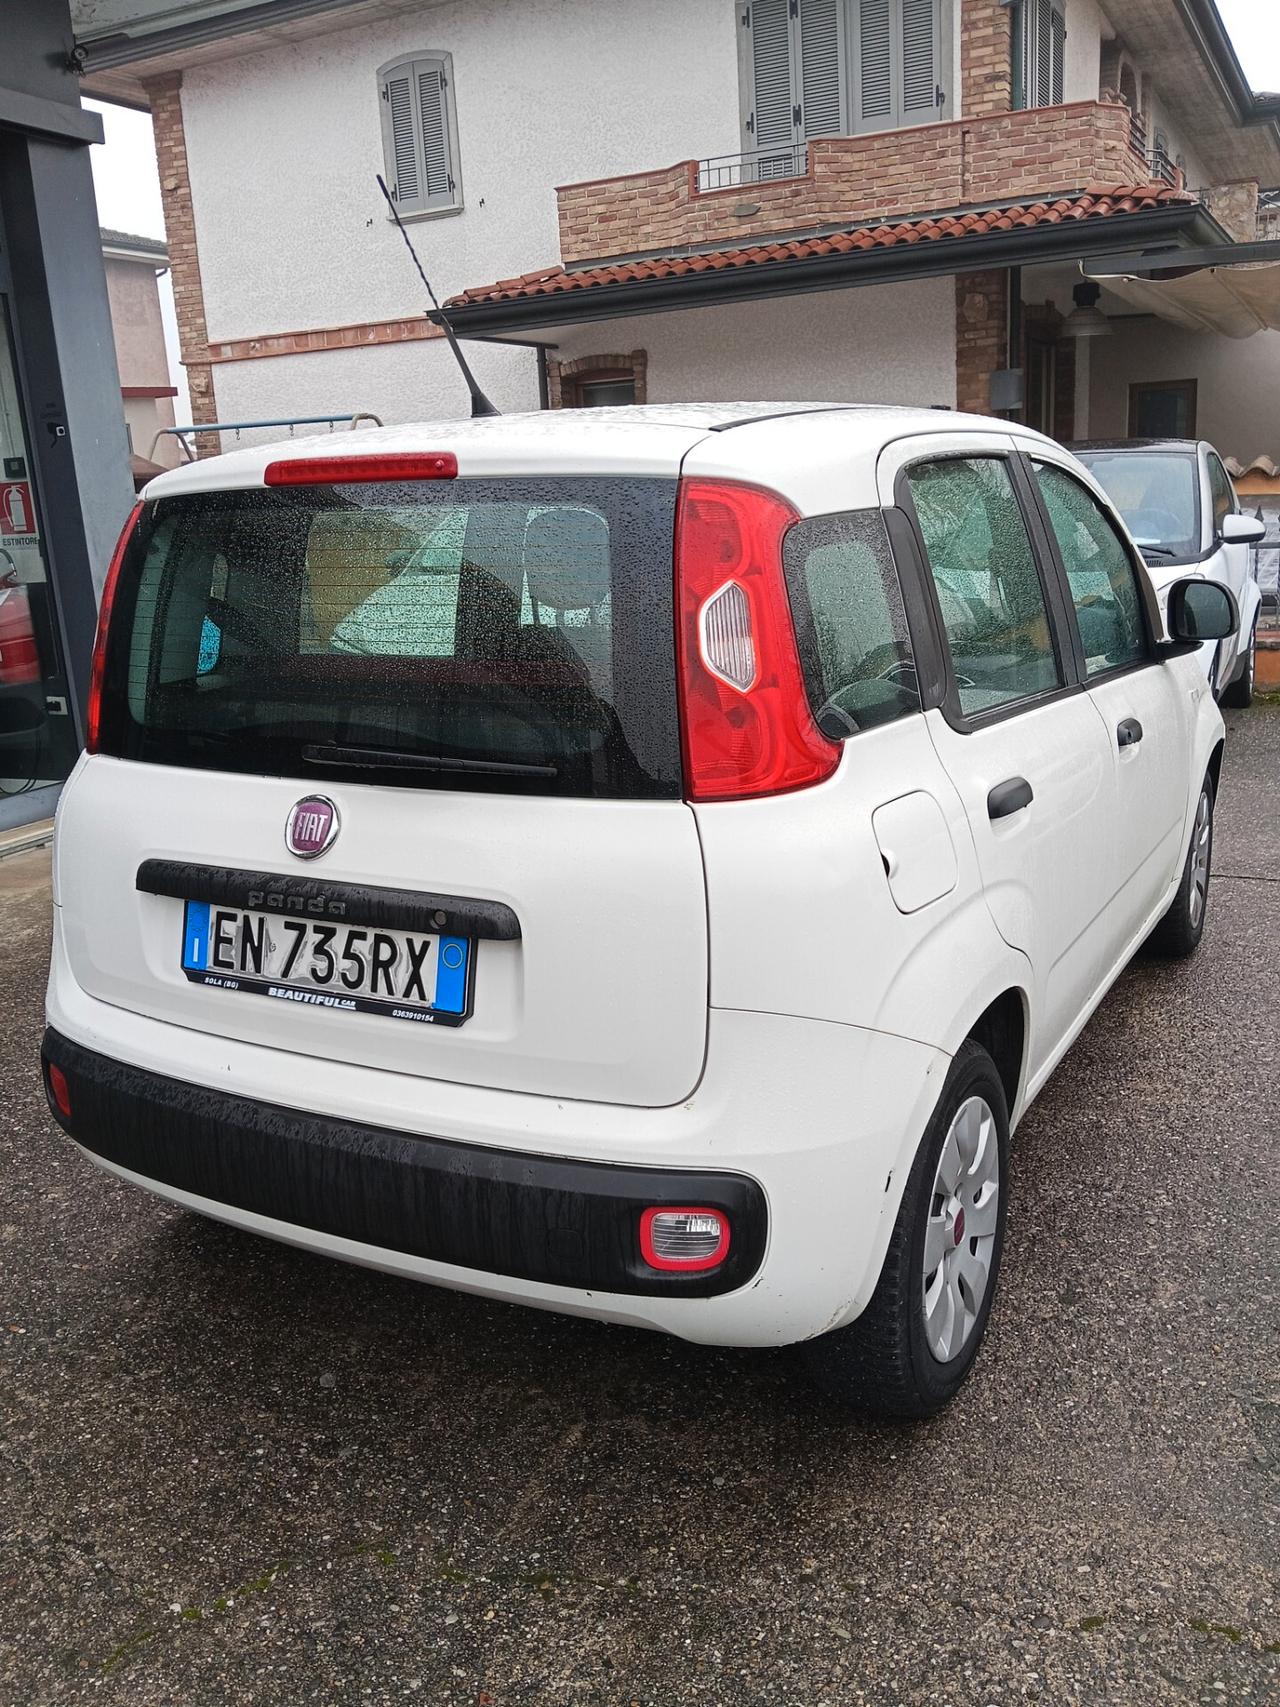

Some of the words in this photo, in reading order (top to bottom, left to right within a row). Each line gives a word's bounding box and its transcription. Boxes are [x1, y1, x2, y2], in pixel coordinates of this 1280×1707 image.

[2, 536, 39, 546] ESTINTORE
[294, 811, 328, 842] FIAT
[204, 977, 222, 986] SOLA
[223, 980, 239, 990] (BG)
[268, 987, 341, 1008] BEAUTIFUL
[392, 1009, 434, 1022] 0363910154
